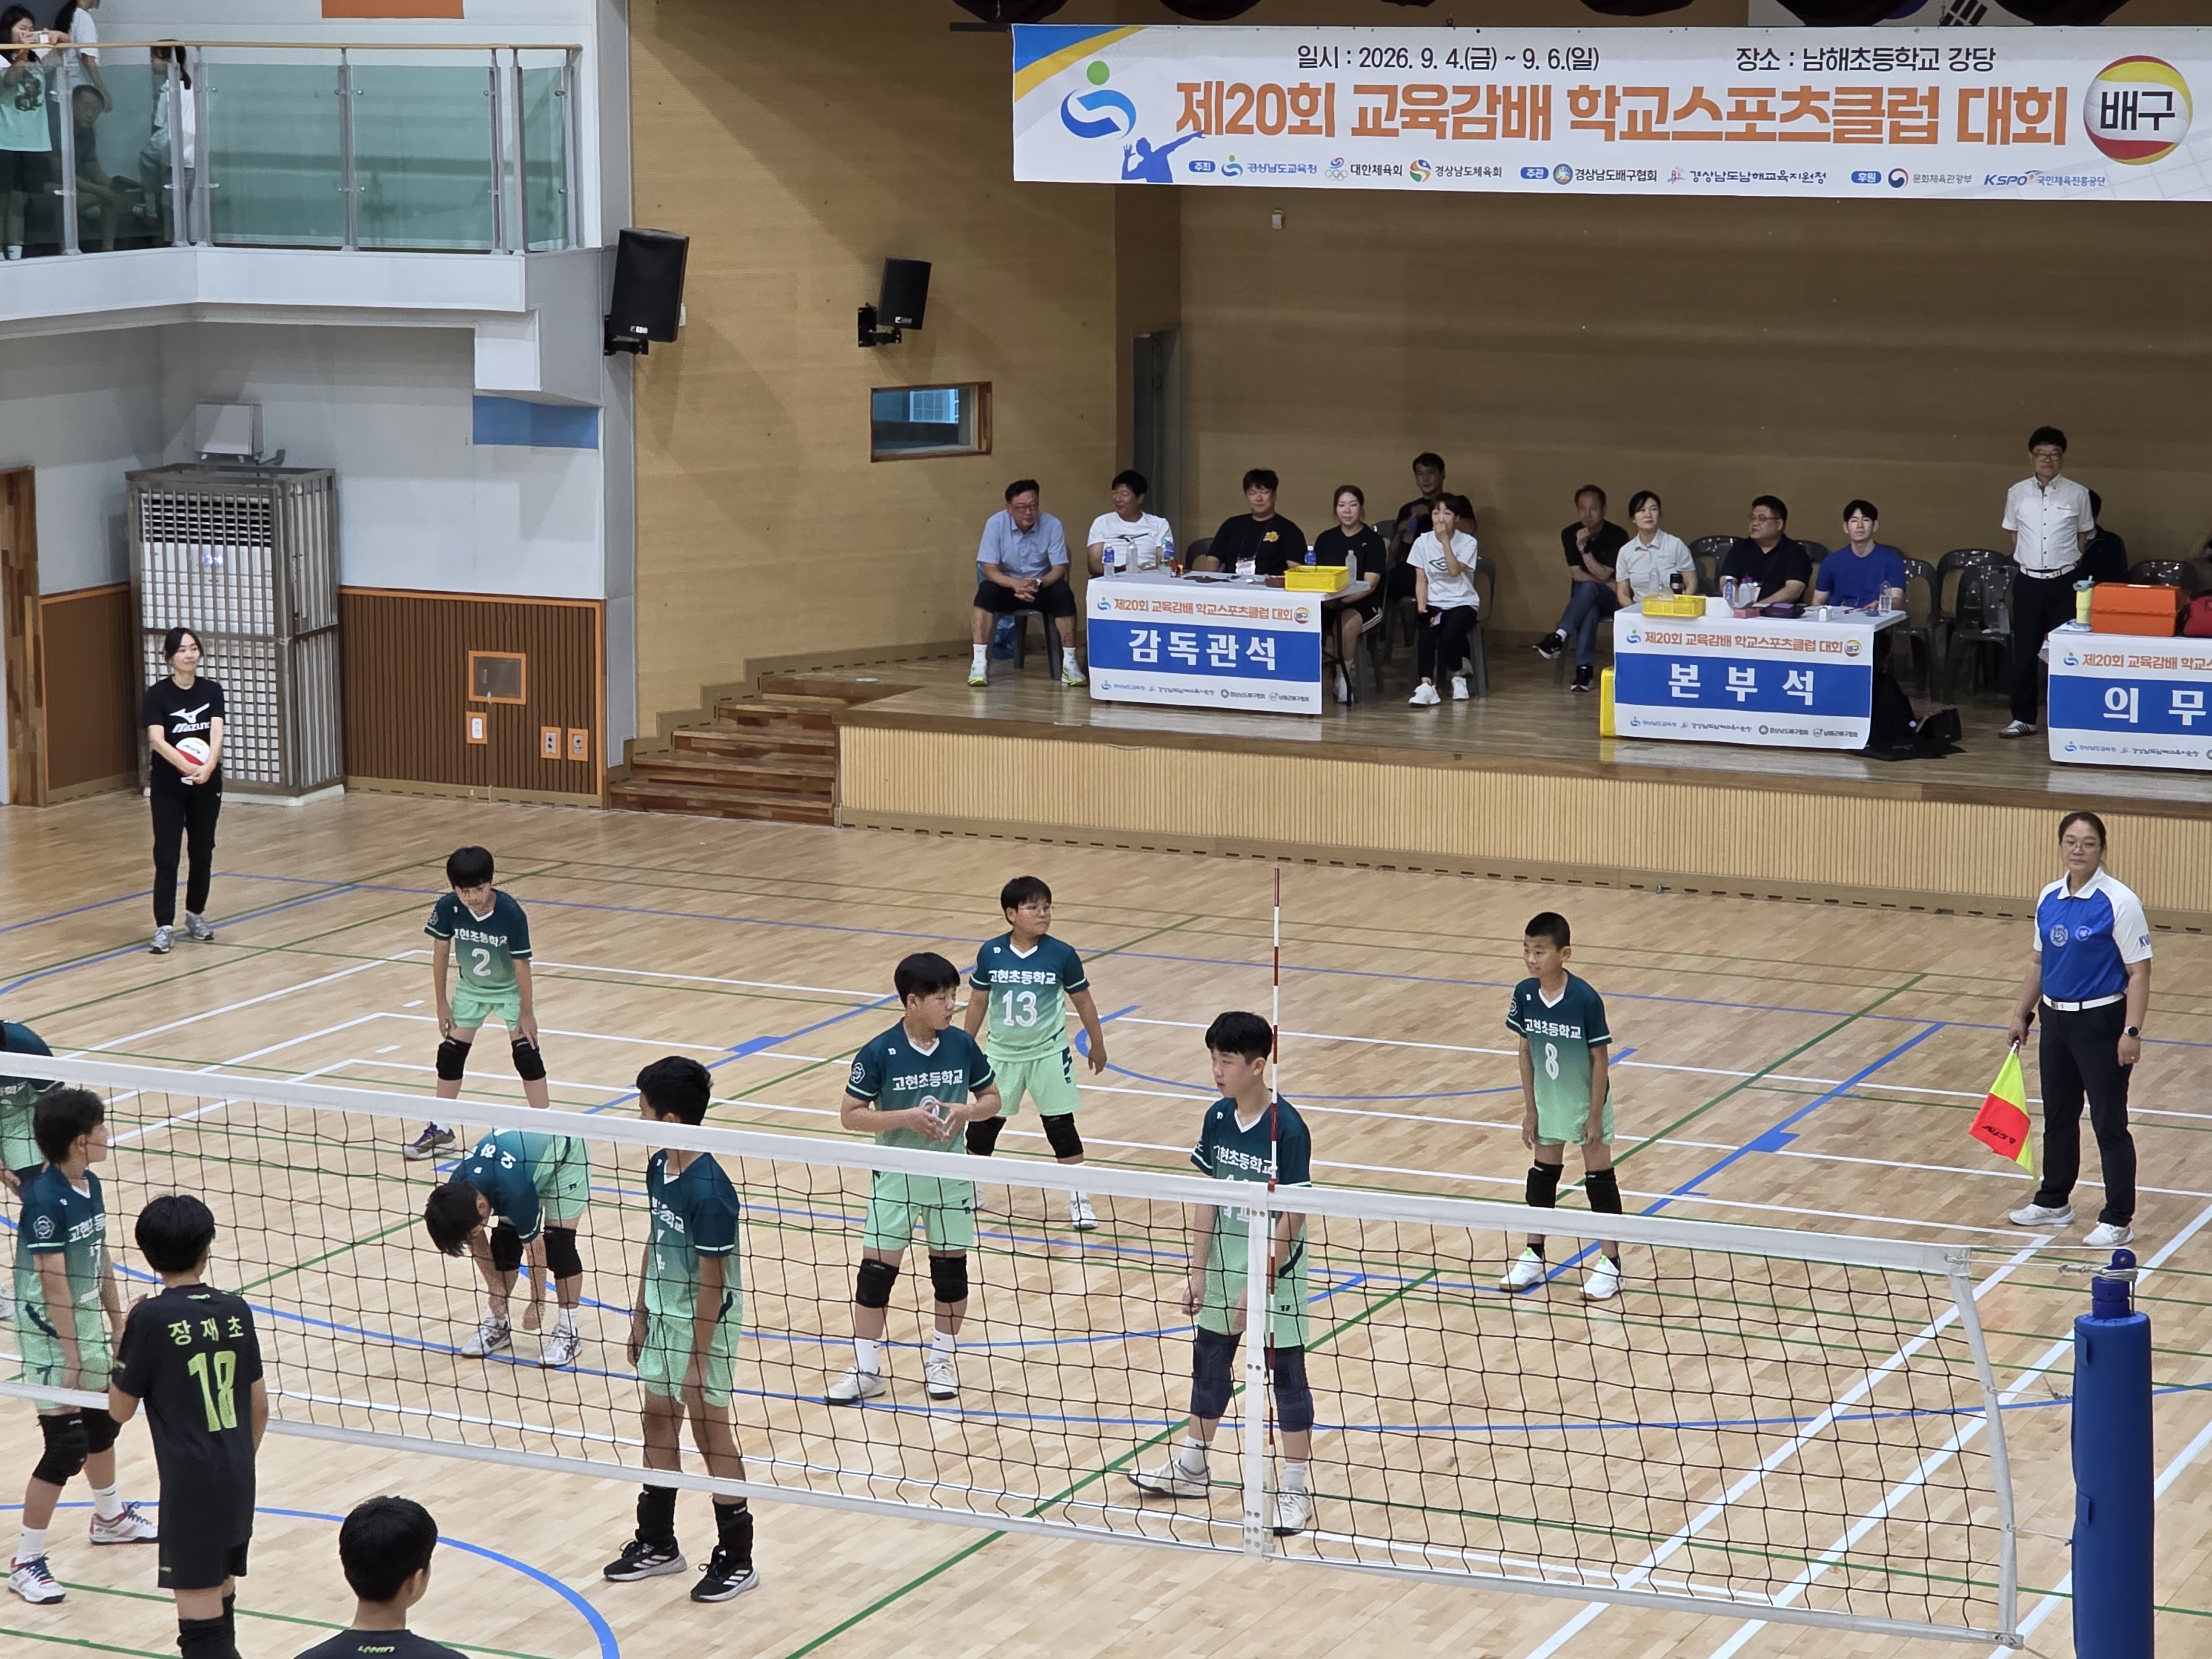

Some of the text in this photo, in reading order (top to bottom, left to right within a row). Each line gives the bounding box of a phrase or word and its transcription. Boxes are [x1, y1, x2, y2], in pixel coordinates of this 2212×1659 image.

[1297, 45, 1339, 69] 일시
[1359, 47, 1413, 69] 2026.
[1421, 48, 1438, 70] 9.
[1445, 47, 1498, 71] 4.(금)
[1522, 48, 1540, 70] 9.
[1548, 47, 1599, 71] 6.(일)
[1736, 48, 1781, 71] 장소
[1803, 46, 1940, 72] 남해초등학교
[1948, 47, 1996, 72] 강당
[1176, 81, 2068, 146] 제20회 교육감배 학교스포츠클럽 대회
[2100, 90, 2176, 131] 배구
[1194, 162, 1211, 171] 주최
[1247, 163, 1317, 174] 경상남도교육청
[1350, 164, 1402, 176] 대한체육회
[1435, 165, 1502, 178] 경상남도체육회
[1526, 168, 1545, 179] 주관
[1575, 169, 1657, 182] 경상남도배구협회
[1689, 170, 1827, 185] 경상남도남해교육지원청
[1858, 172, 1876, 183] 후원
[1913, 174, 1972, 184] 문화체육관광부
[1984, 174, 2027, 186] KSPO
[2037, 175, 2106, 187] 국민체육진흥공단
[1114, 598, 1292, 622] 제20회 교육감배 학교스포츠클럽 대회
[1128, 629, 1276, 671] 감독관석
[1645, 632, 1843, 654] 제20회 교육감배 학교스포츠클럽 대회
[2083, 654, 2124, 667] 제20회
[2127, 655, 2178, 670] 교육감배
[472, 948, 491, 977] 2
[988, 969, 1056, 985] 고현초등학교
[1002, 990, 1037, 1027] 13
[1524, 1019, 1582, 1039] 고현초등학교
[1545, 1042, 1559, 1080] 8
[892, 1069, 963, 1091] 고현초등학교
[168, 1316, 244, 1346] 장재초
